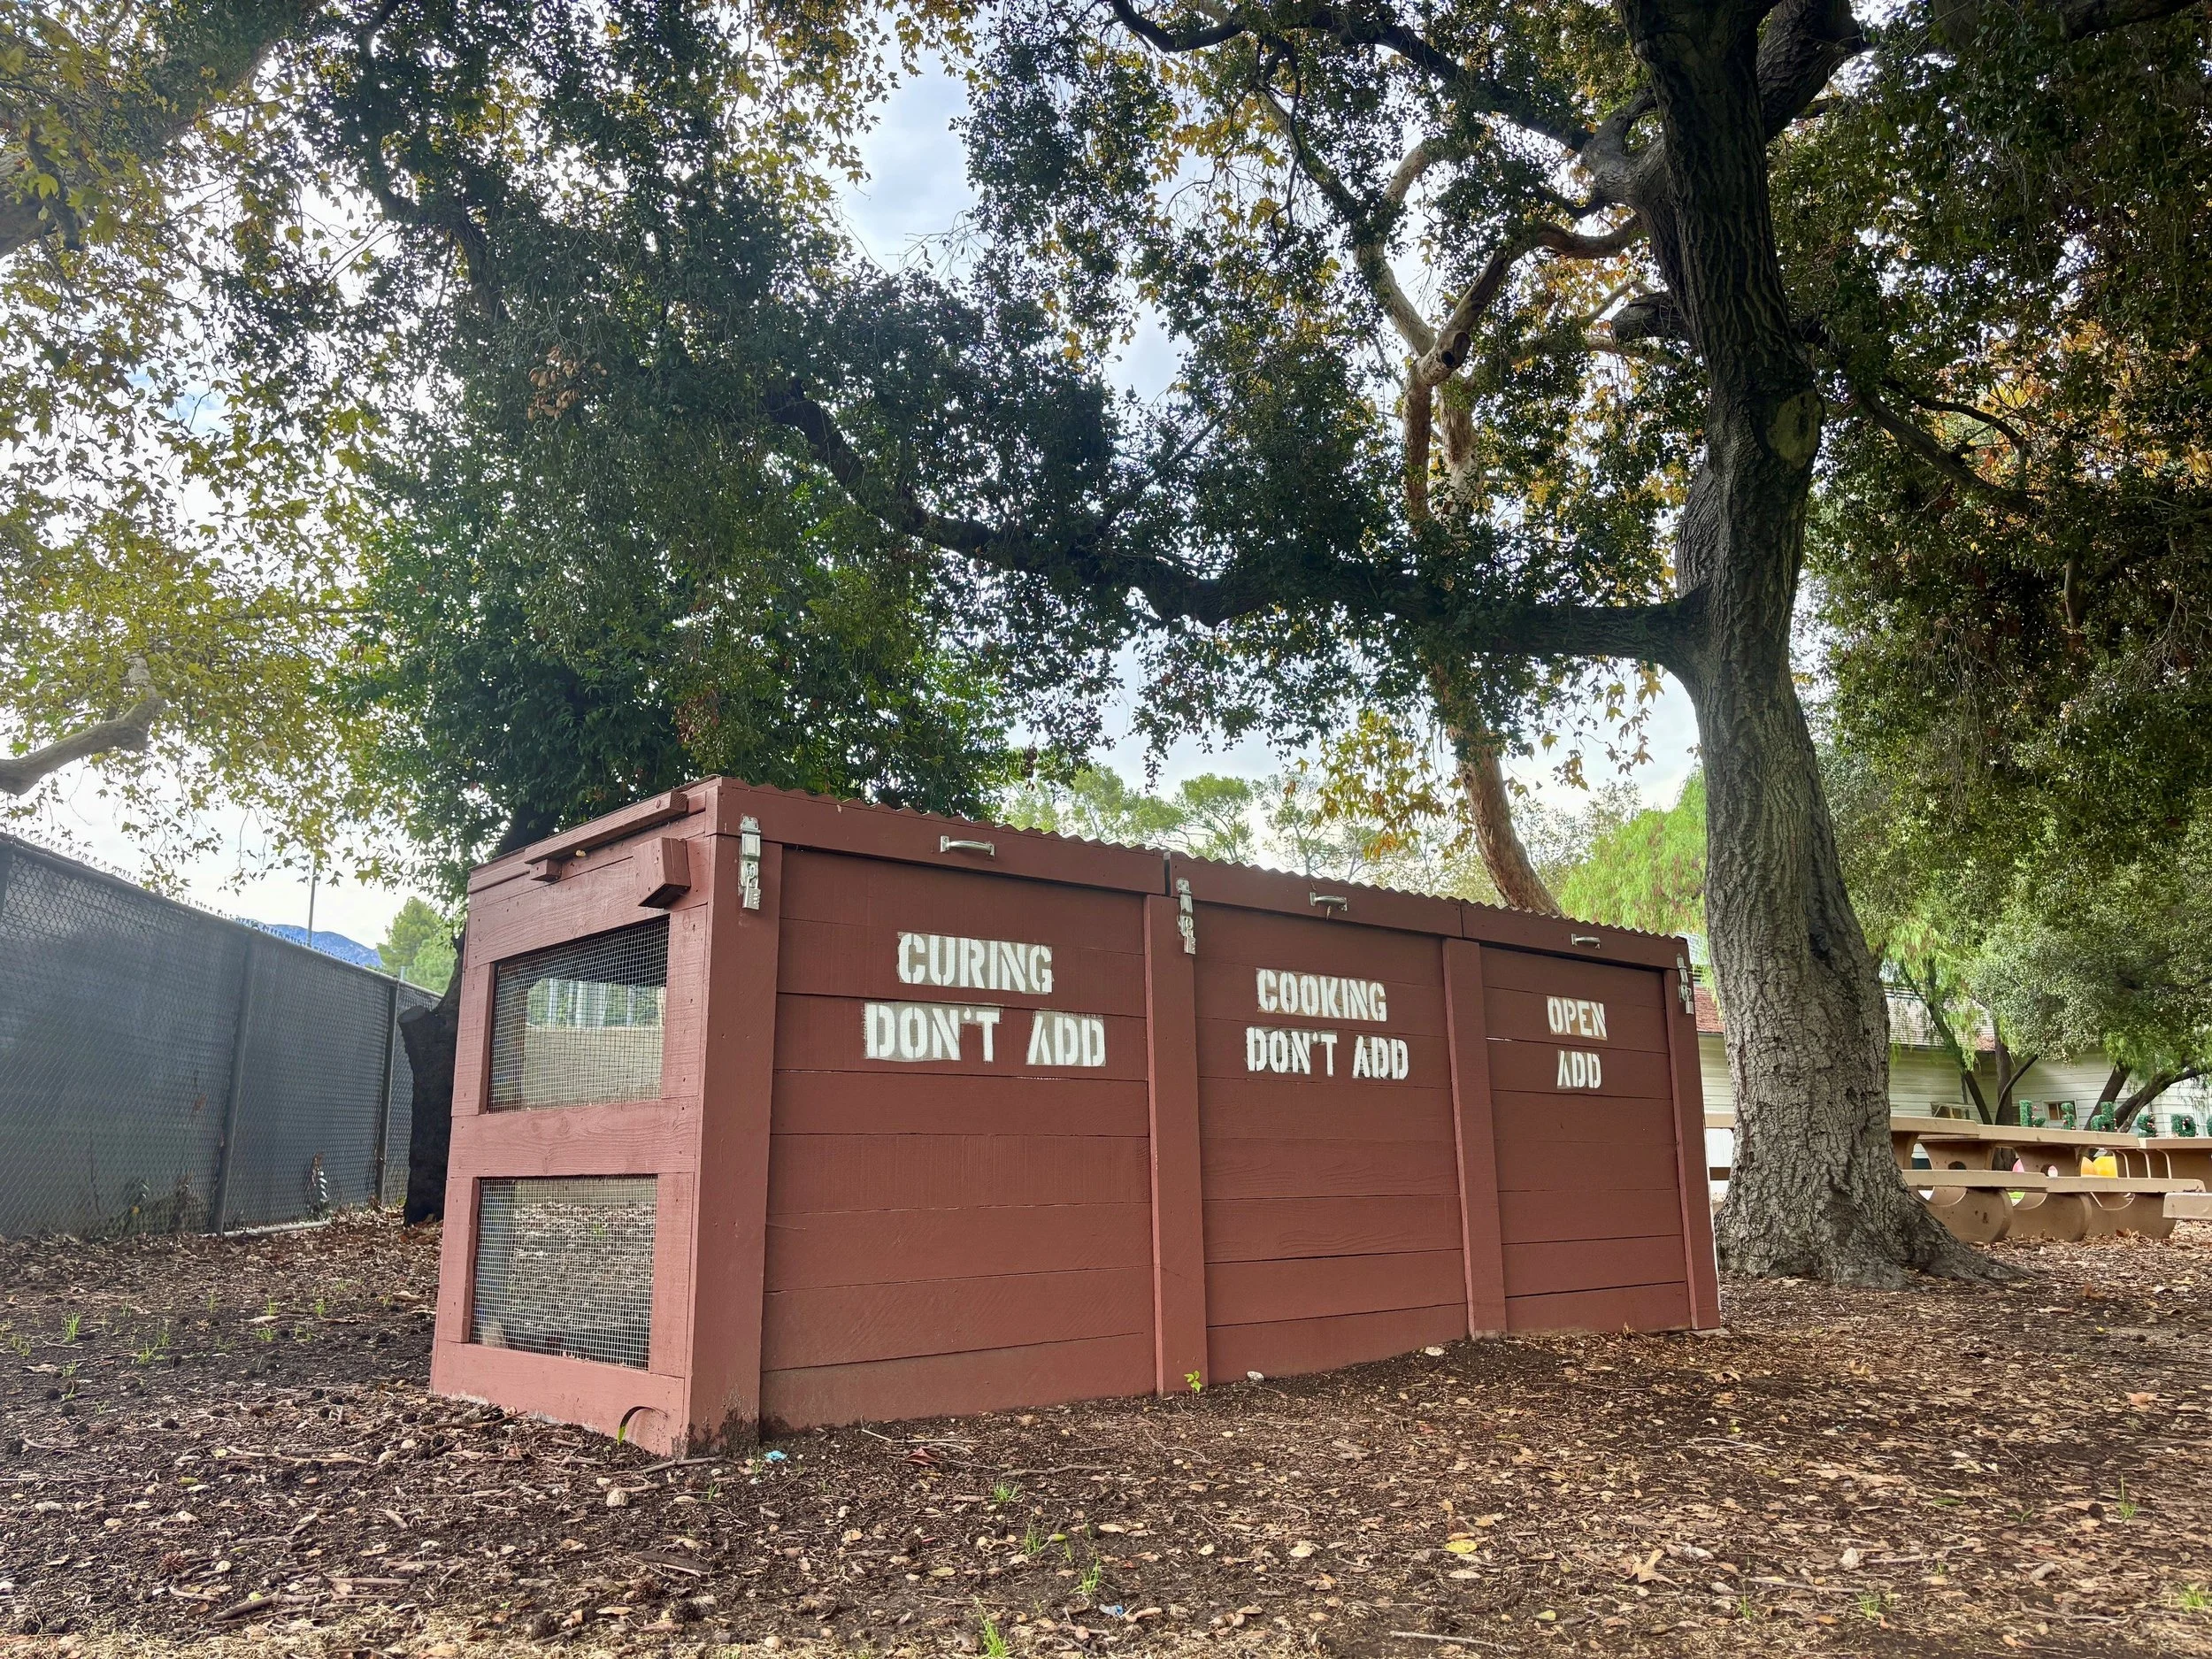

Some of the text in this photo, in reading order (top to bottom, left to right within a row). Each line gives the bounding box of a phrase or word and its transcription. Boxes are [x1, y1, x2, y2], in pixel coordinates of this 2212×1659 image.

[899, 933, 1053, 993] CURING
[1257, 969, 1387, 1021] COOKING
[1548, 998, 1607, 1038] OPEN
[864, 1003, 1105, 1066] DON'T ADD
[1247, 1027, 1408, 1079] DON'T ADD
[1557, 1051, 1601, 1088] ADD
